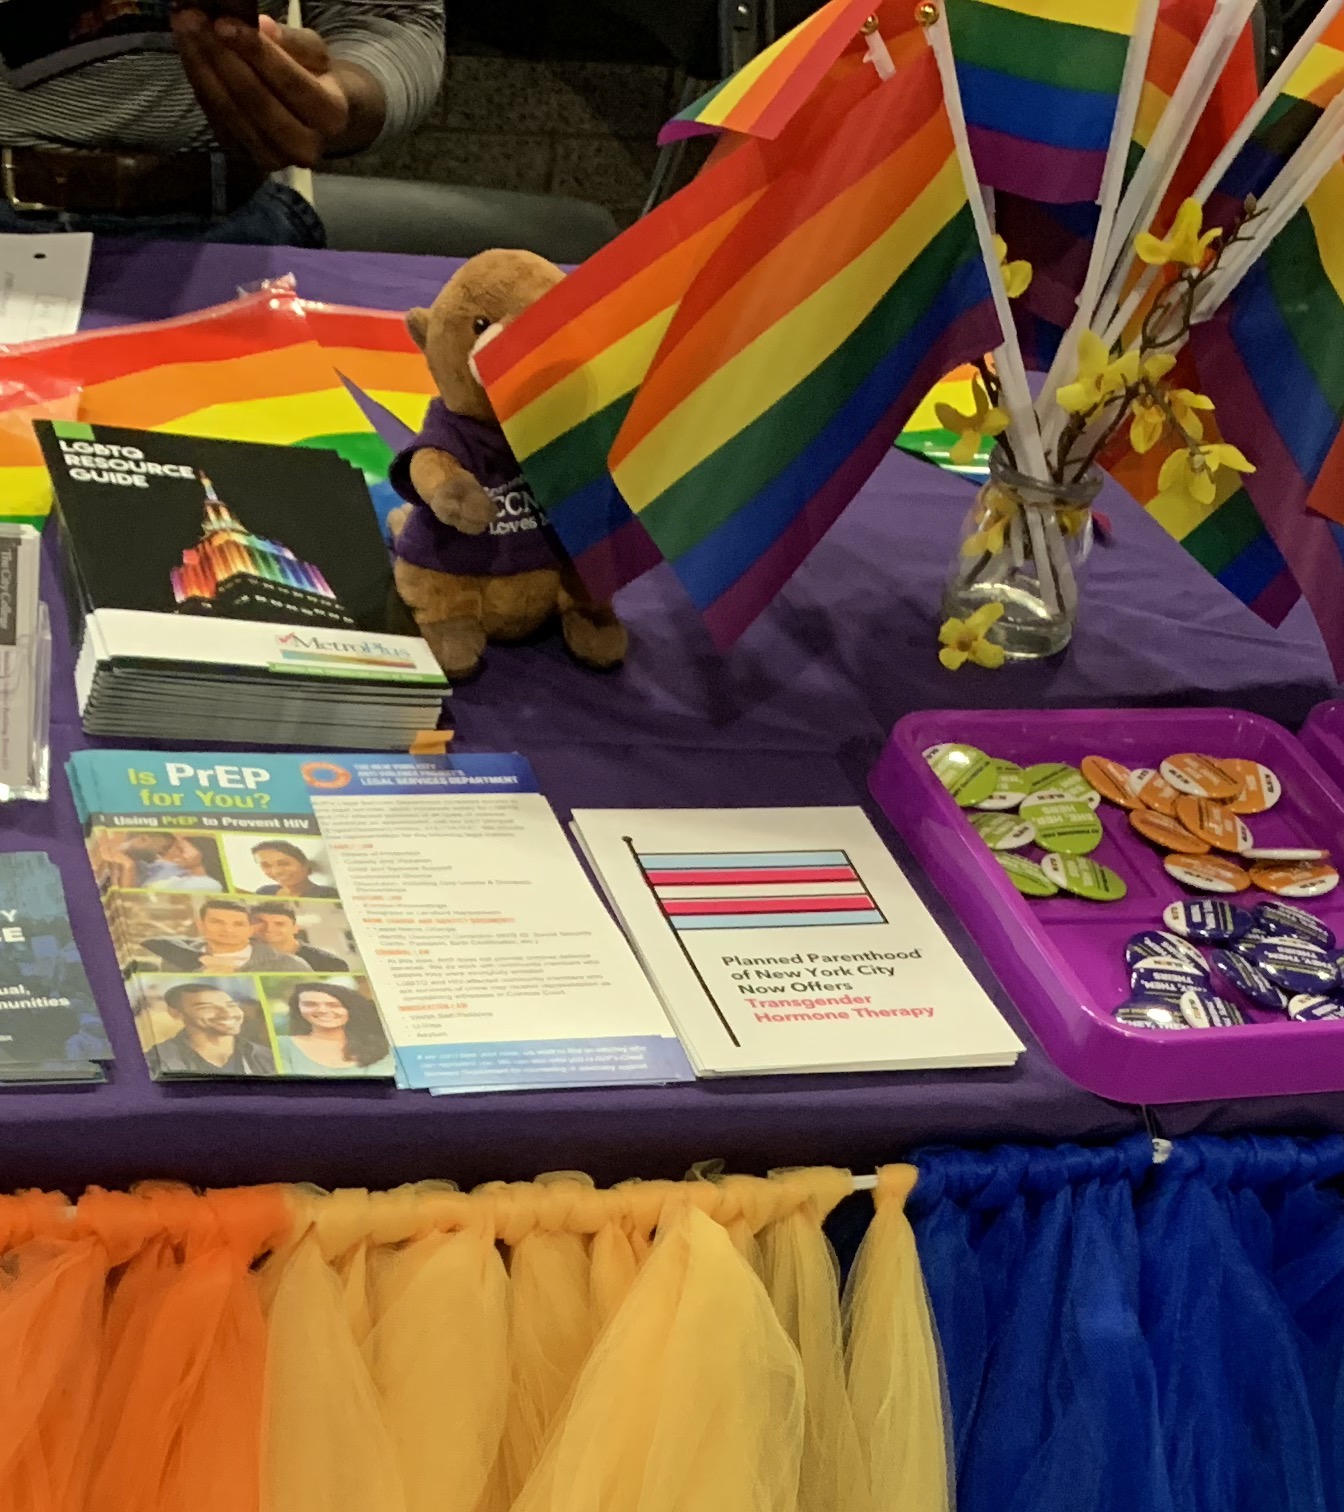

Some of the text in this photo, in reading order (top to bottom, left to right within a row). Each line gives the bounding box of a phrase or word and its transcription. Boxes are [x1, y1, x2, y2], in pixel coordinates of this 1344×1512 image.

[58, 440, 144, 460] LGBTQ
[63, 453, 196, 479] RESOURCE
[69, 467, 149, 489] GUIDE
[0, 548, 12, 570] The
[290, 633, 413, 659] MetroPlus
[127, 762, 272, 790] Is PrEP
[138, 788, 272, 809] for You?
[113, 815, 311, 830] Using PrEP to Prevent HIV
[722, 947, 924, 969] Planned Parenthood
[730, 961, 896, 984] of New York City
[737, 978, 854, 996] Now Offers
[744, 993, 873, 1012] Transgender
[753, 1003, 936, 1025] Hormone Therapy
